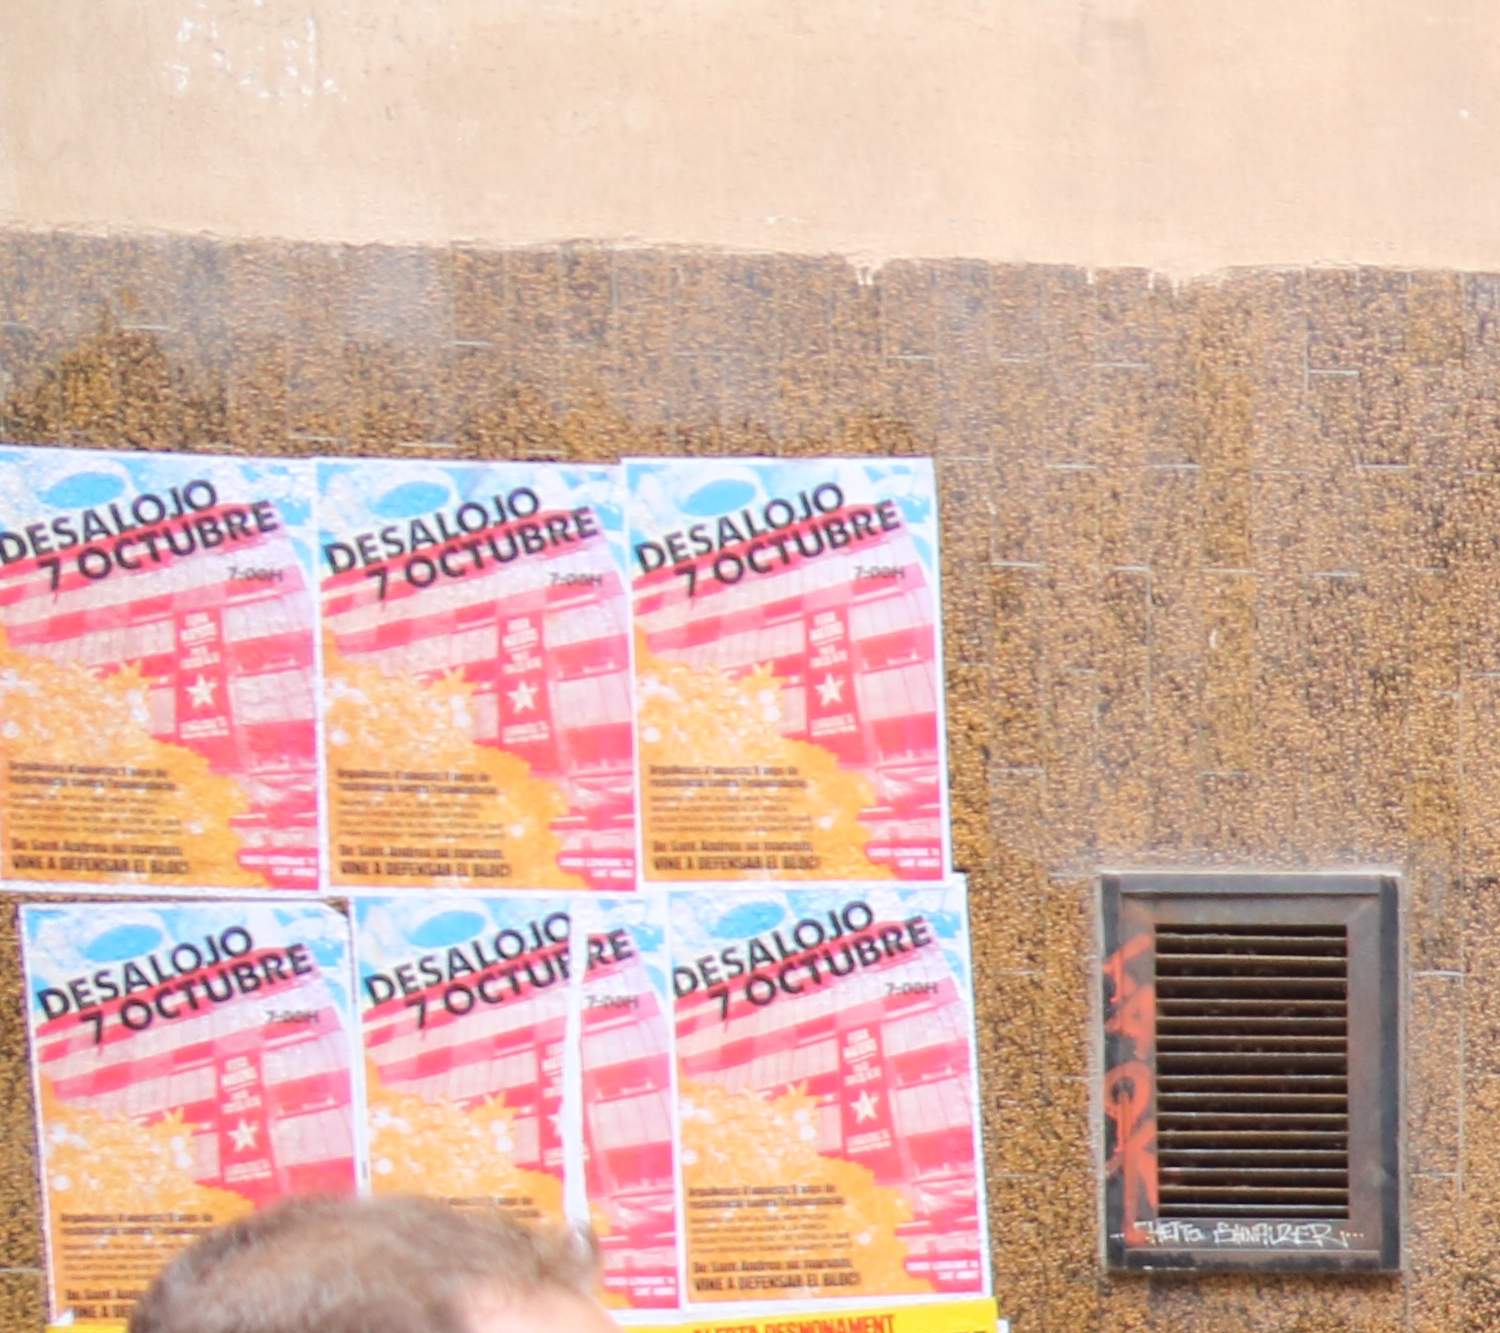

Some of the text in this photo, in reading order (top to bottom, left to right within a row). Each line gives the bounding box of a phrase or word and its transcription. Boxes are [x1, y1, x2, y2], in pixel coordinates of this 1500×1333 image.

[0, 479, 218, 565] DESALOJO
[39, 500, 280, 591] 7 OCTUBRE
[323, 487, 540, 576] DESALOJO
[366, 507, 599, 599] 7 OCTUBRE
[635, 483, 844, 574] DESALOJO
[675, 500, 901, 597] 7 OCTUBRE
[37, 925, 254, 1020] DESALOJO
[79, 944, 314, 1044] 7 OCTUBRE
[365, 913, 572, 1006] DESALOJO
[672, 901, 874, 998] DESALOJO
[708, 916, 933, 1021] 7 OCTUBRE
[405, 999, 427, 1030] 7
